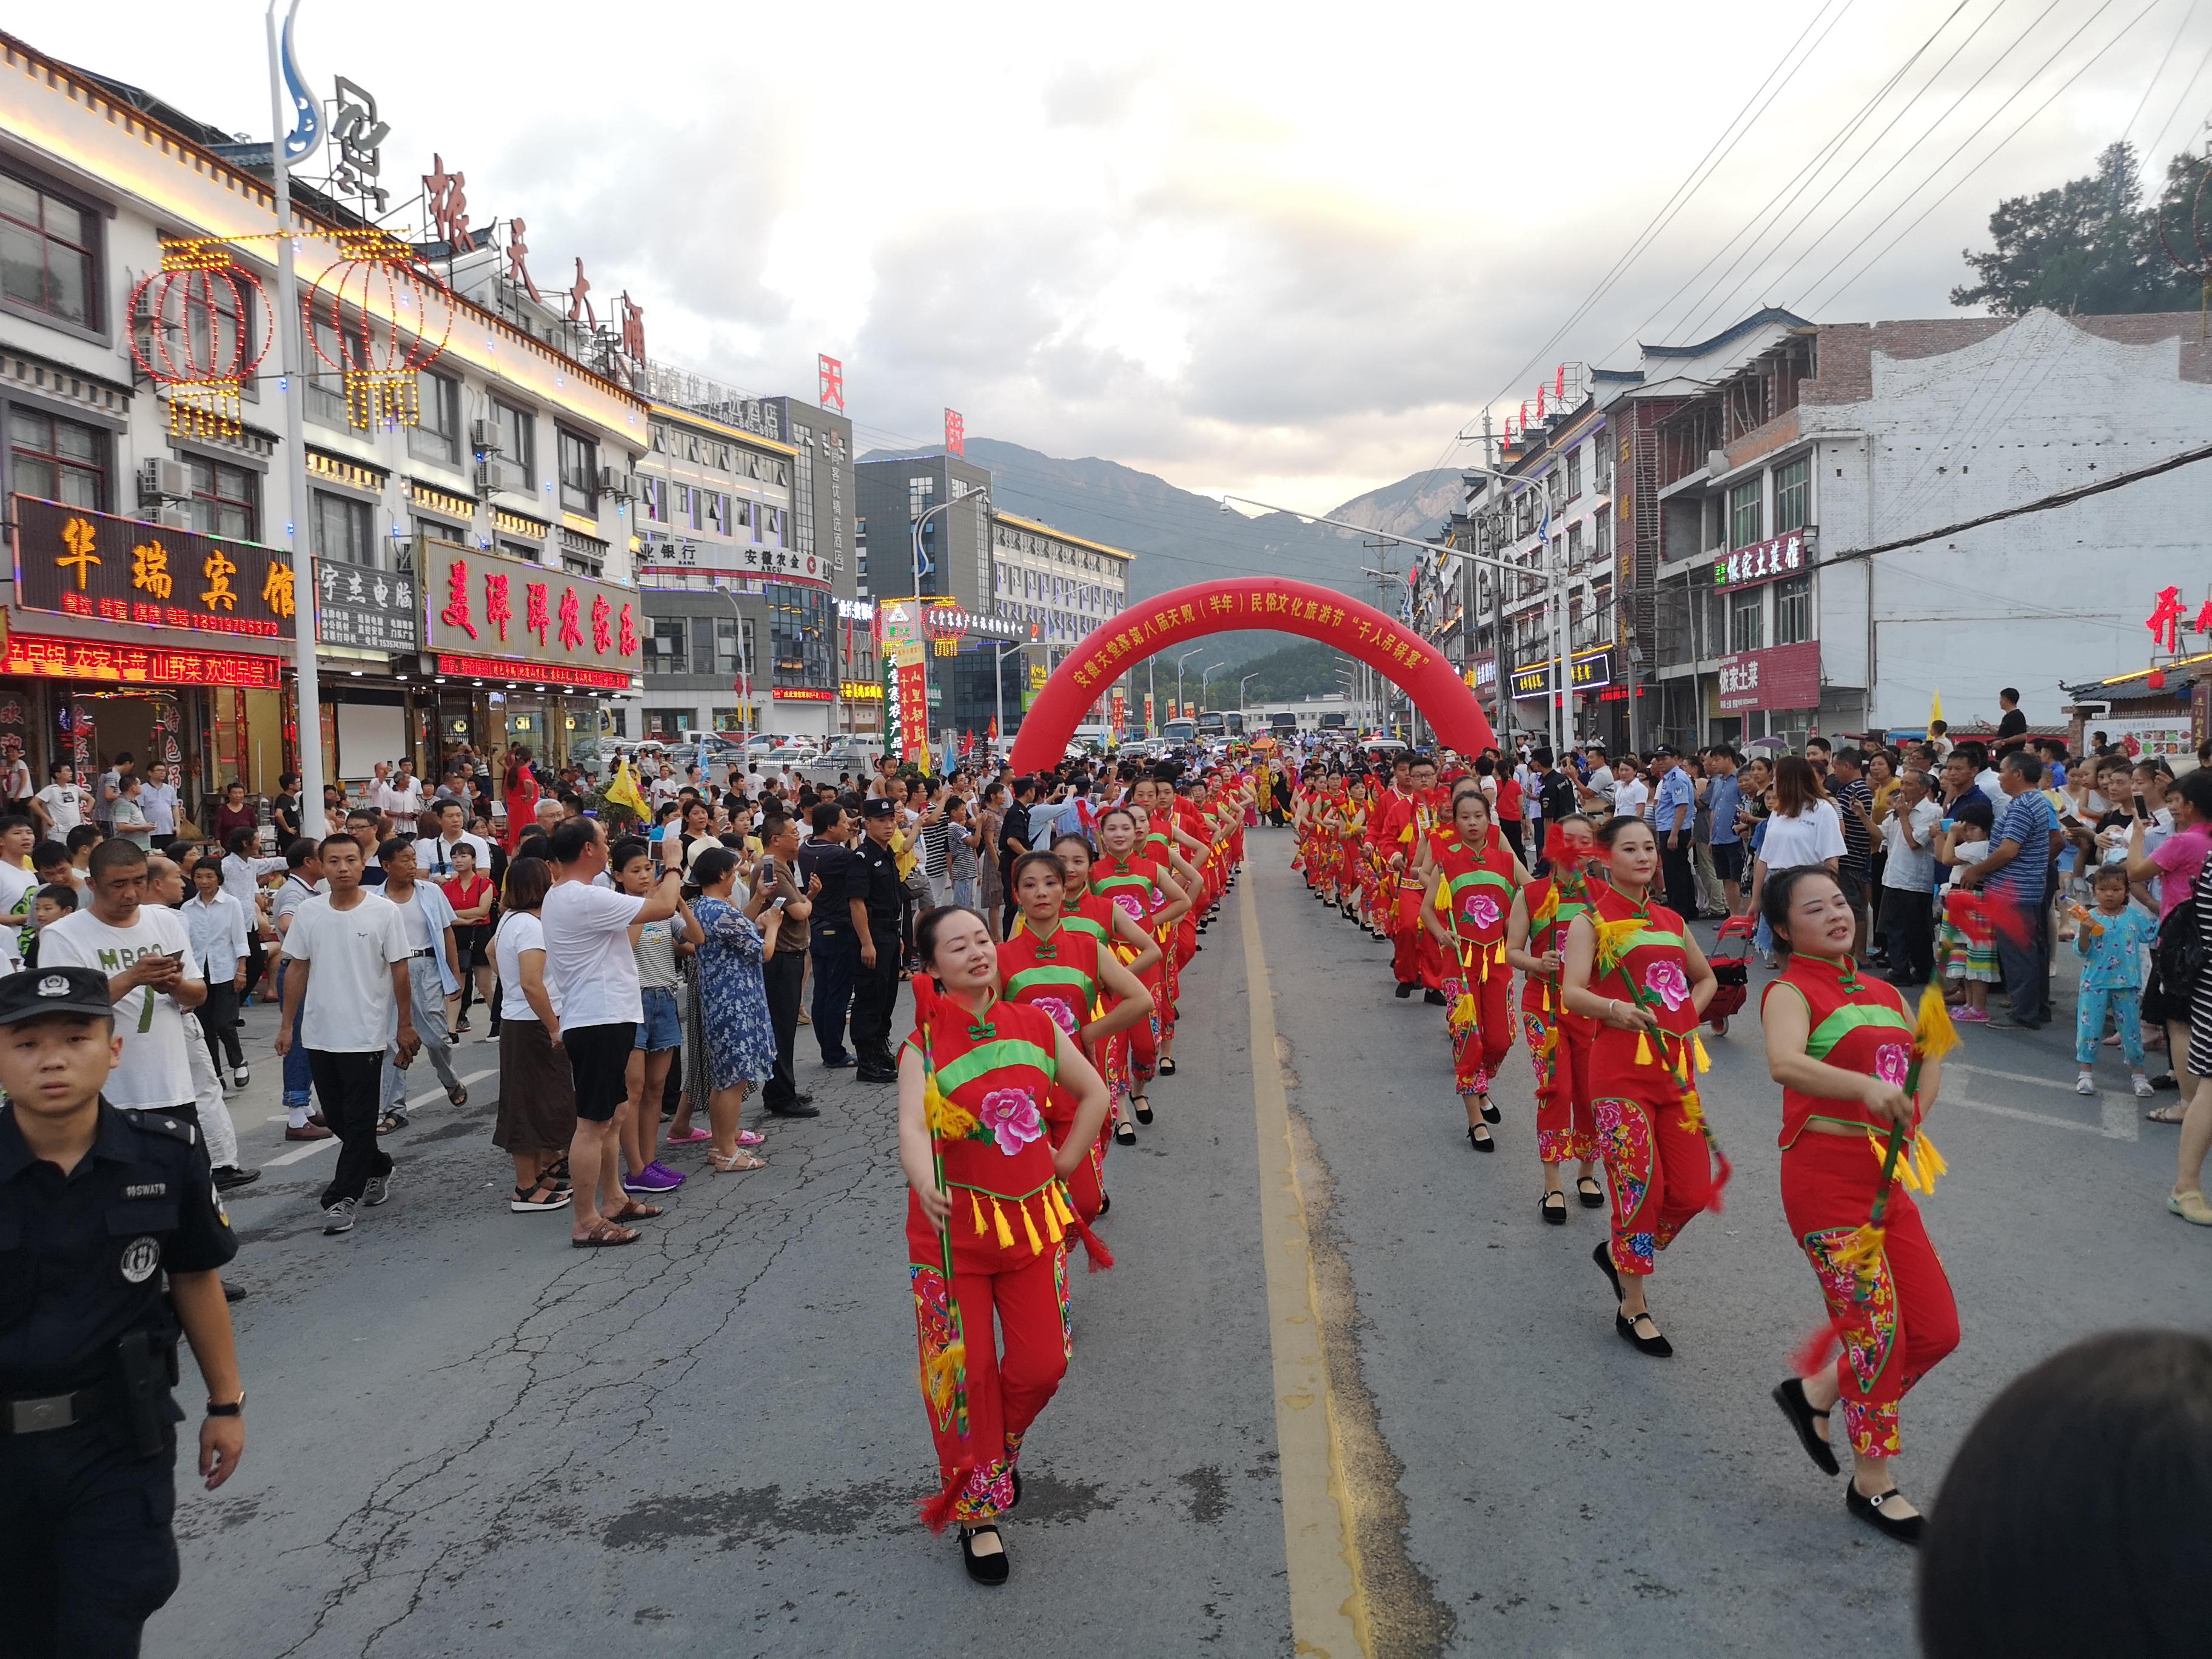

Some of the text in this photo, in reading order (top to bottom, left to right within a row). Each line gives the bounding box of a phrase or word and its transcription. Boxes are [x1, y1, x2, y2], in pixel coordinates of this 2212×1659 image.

[820, 354, 845, 408] 天
[717, 411, 779, 440] 400-645-6999
[830, 451, 845, 572] 尚客优精选酒店
[55, 516, 296, 618] 华瑞宾馆
[745, 548, 800, 569] 安徽农金
[152, 653, 203, 681] 山野菜
[205, 657, 275, 685] 欢迎品尝！
